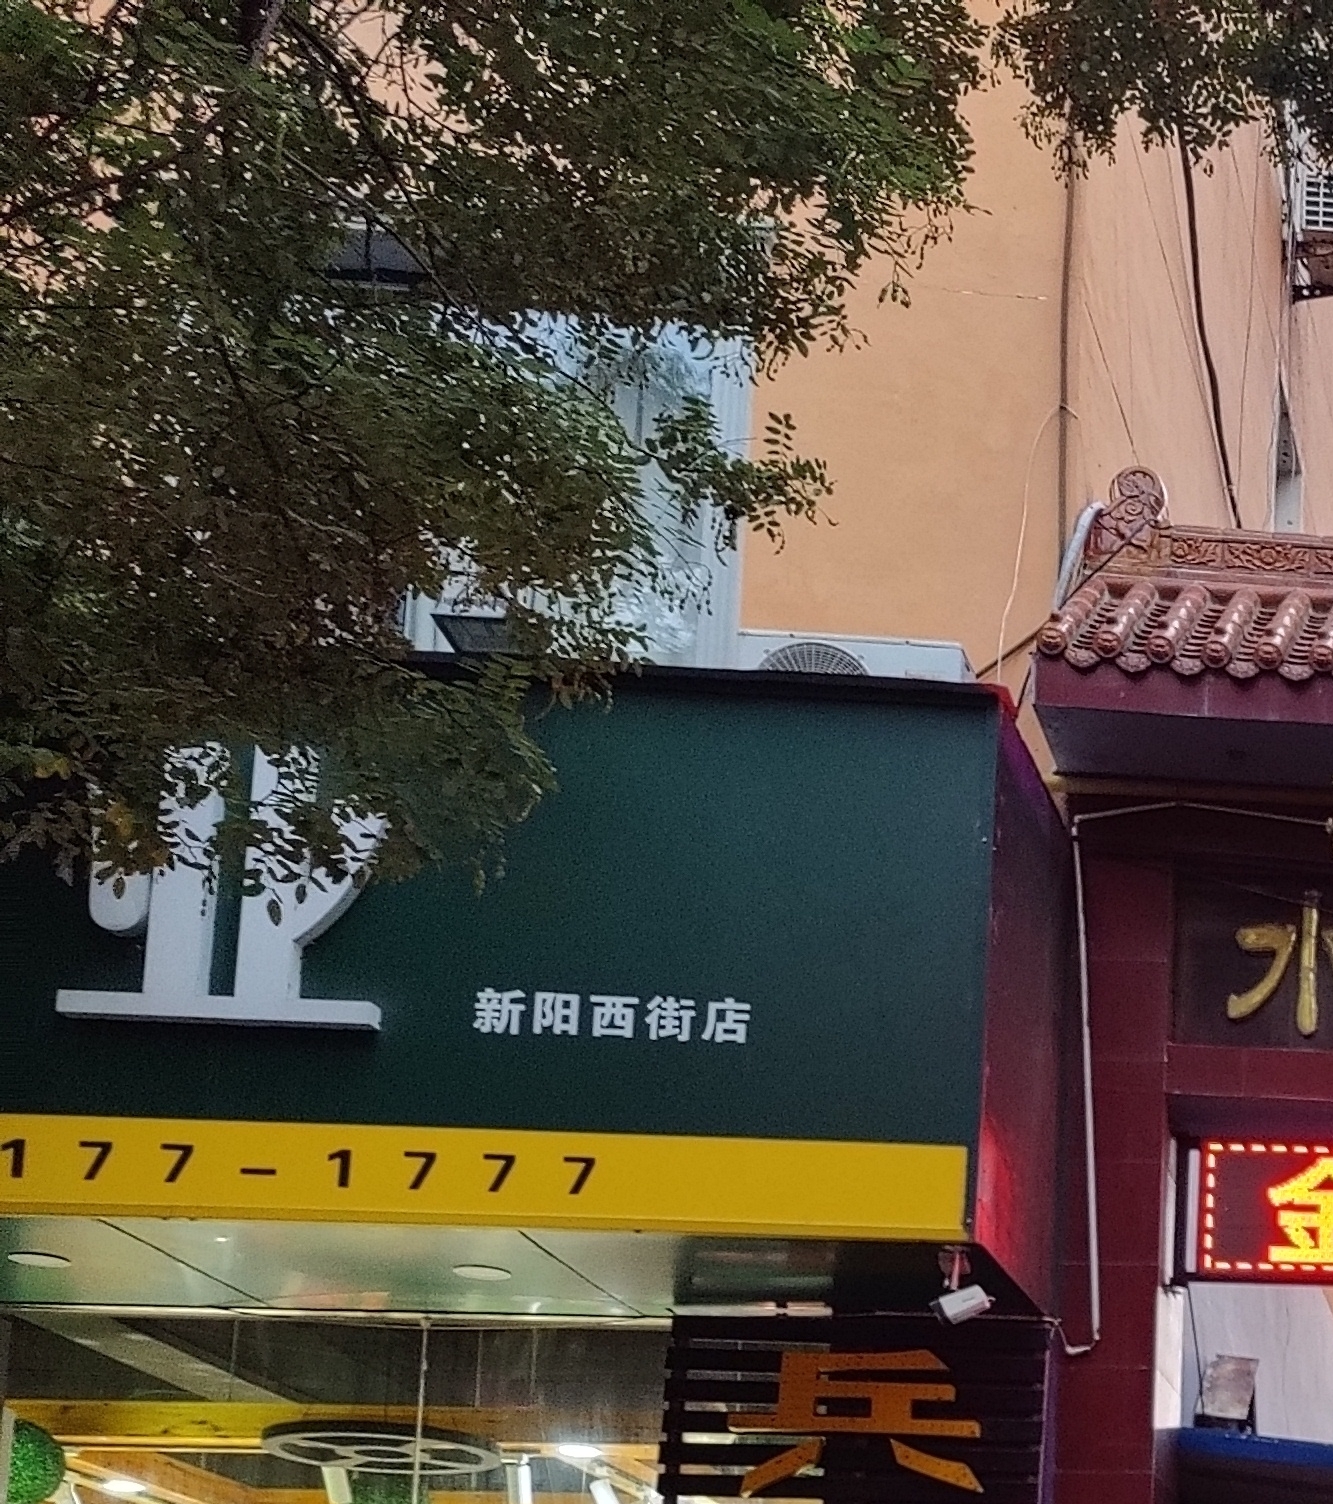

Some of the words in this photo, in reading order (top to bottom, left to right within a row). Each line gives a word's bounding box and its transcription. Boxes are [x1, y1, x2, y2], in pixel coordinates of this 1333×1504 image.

[473, 988, 751, 1043] 新阳西街店
